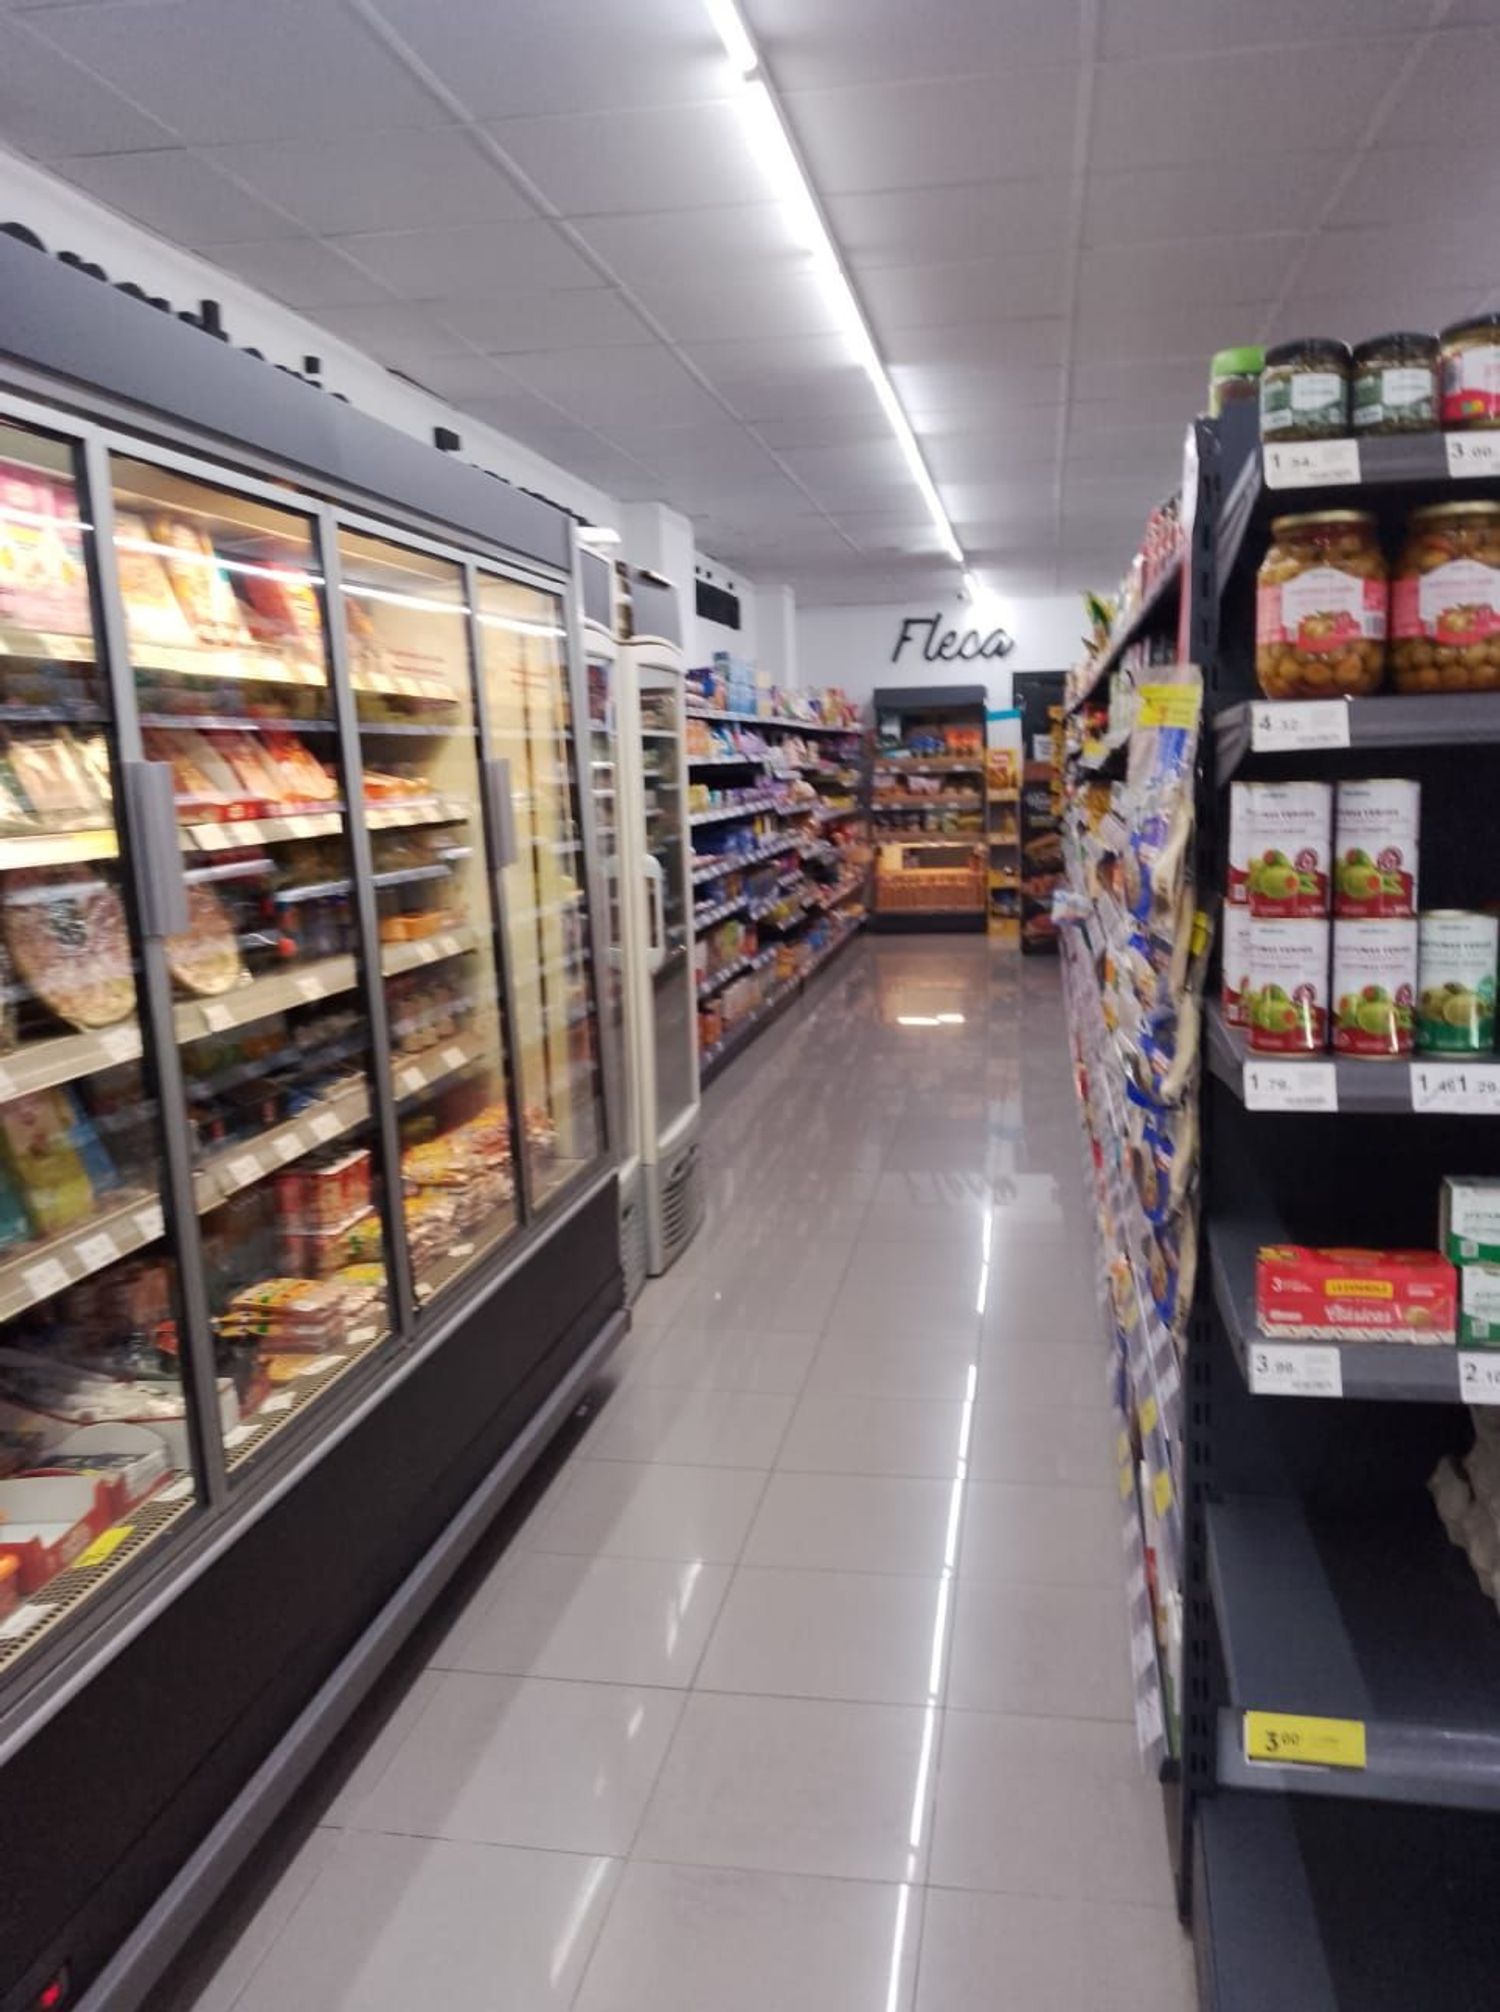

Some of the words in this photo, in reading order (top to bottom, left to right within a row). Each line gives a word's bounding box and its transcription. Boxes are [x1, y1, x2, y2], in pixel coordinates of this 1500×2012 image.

[892, 612, 1015, 663] Fleca
[1256, 1354, 1269, 1374] 3
[1464, 1362, 1478, 1383] 2
[1264, 1731, 1279, 1753] 3
